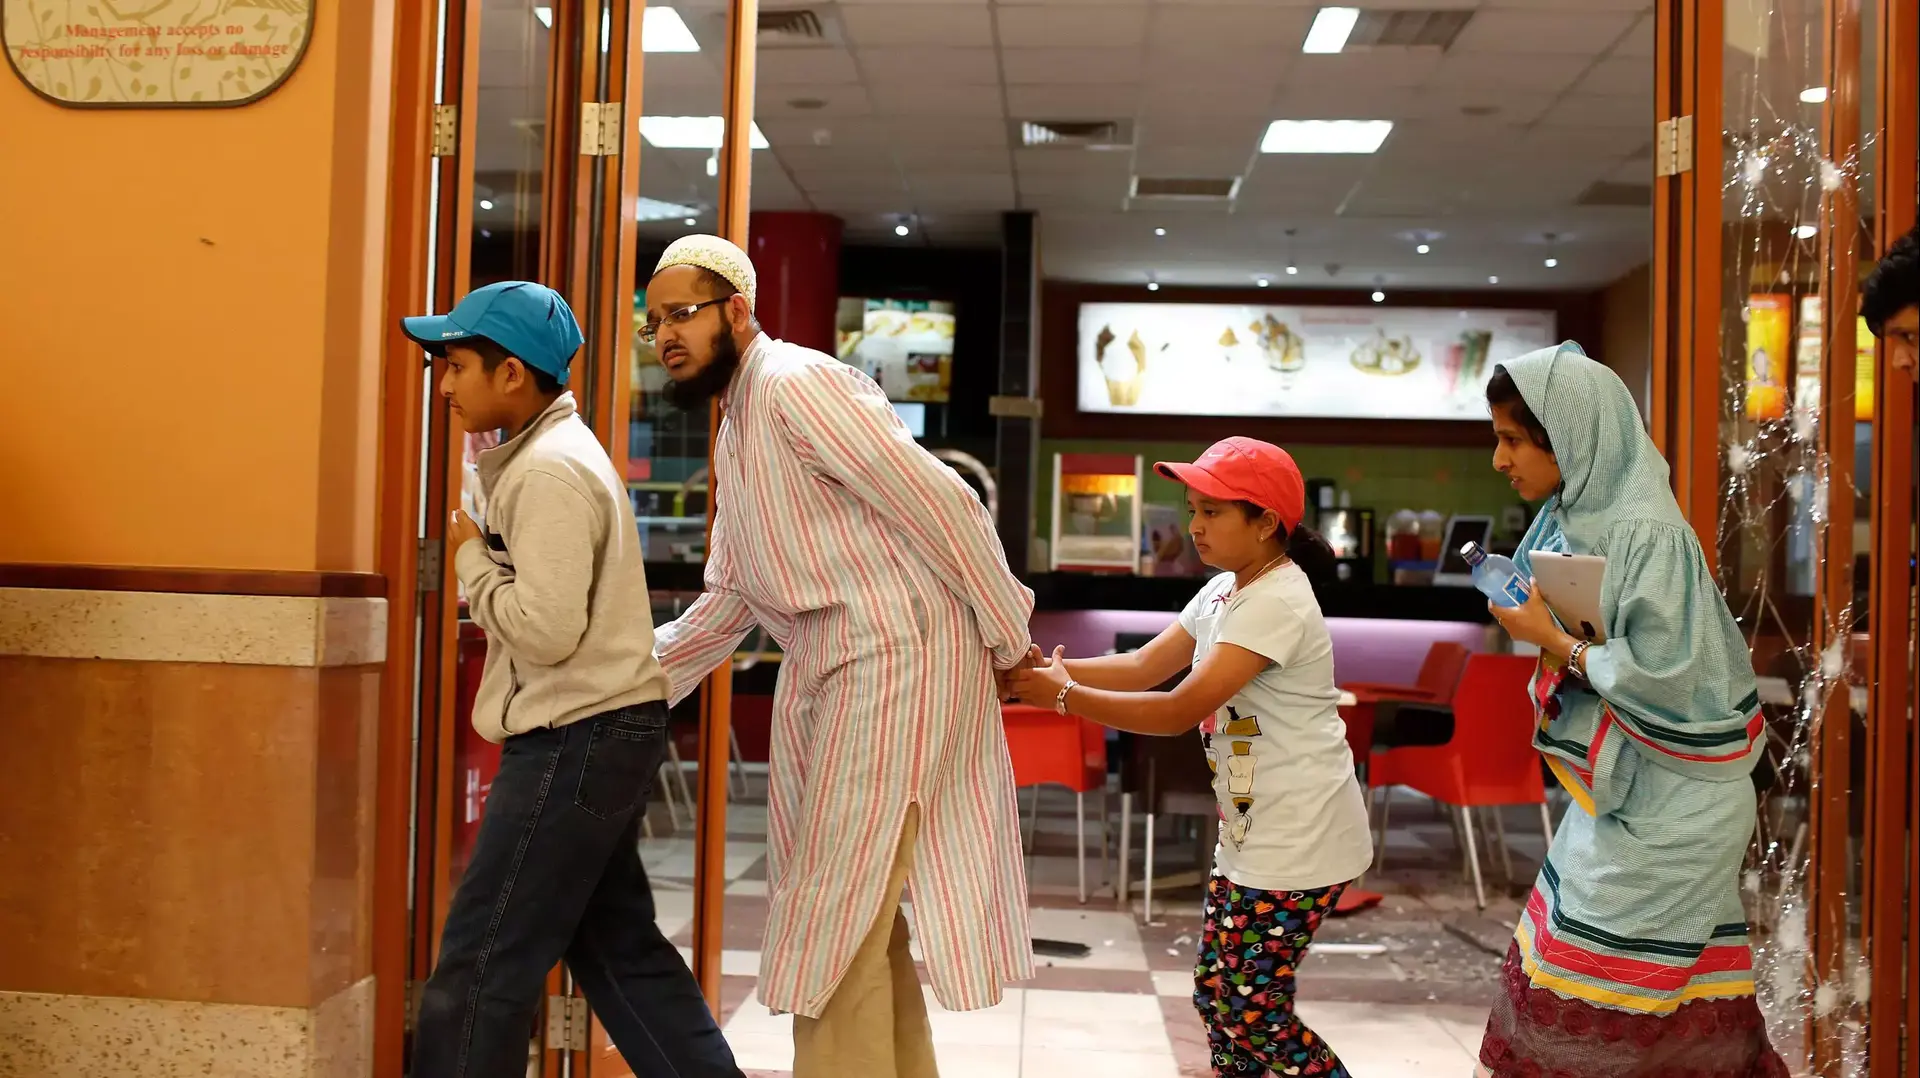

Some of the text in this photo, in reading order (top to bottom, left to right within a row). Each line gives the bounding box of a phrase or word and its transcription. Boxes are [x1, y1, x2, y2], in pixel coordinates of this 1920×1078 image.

[65, 23, 245, 39] Management accepts no
[119, 43, 141, 57] for
[145, 46, 171, 60] any
[176, 42, 204, 56] loss
[206, 46, 225, 56] or
[229, 41, 289, 58] damage
